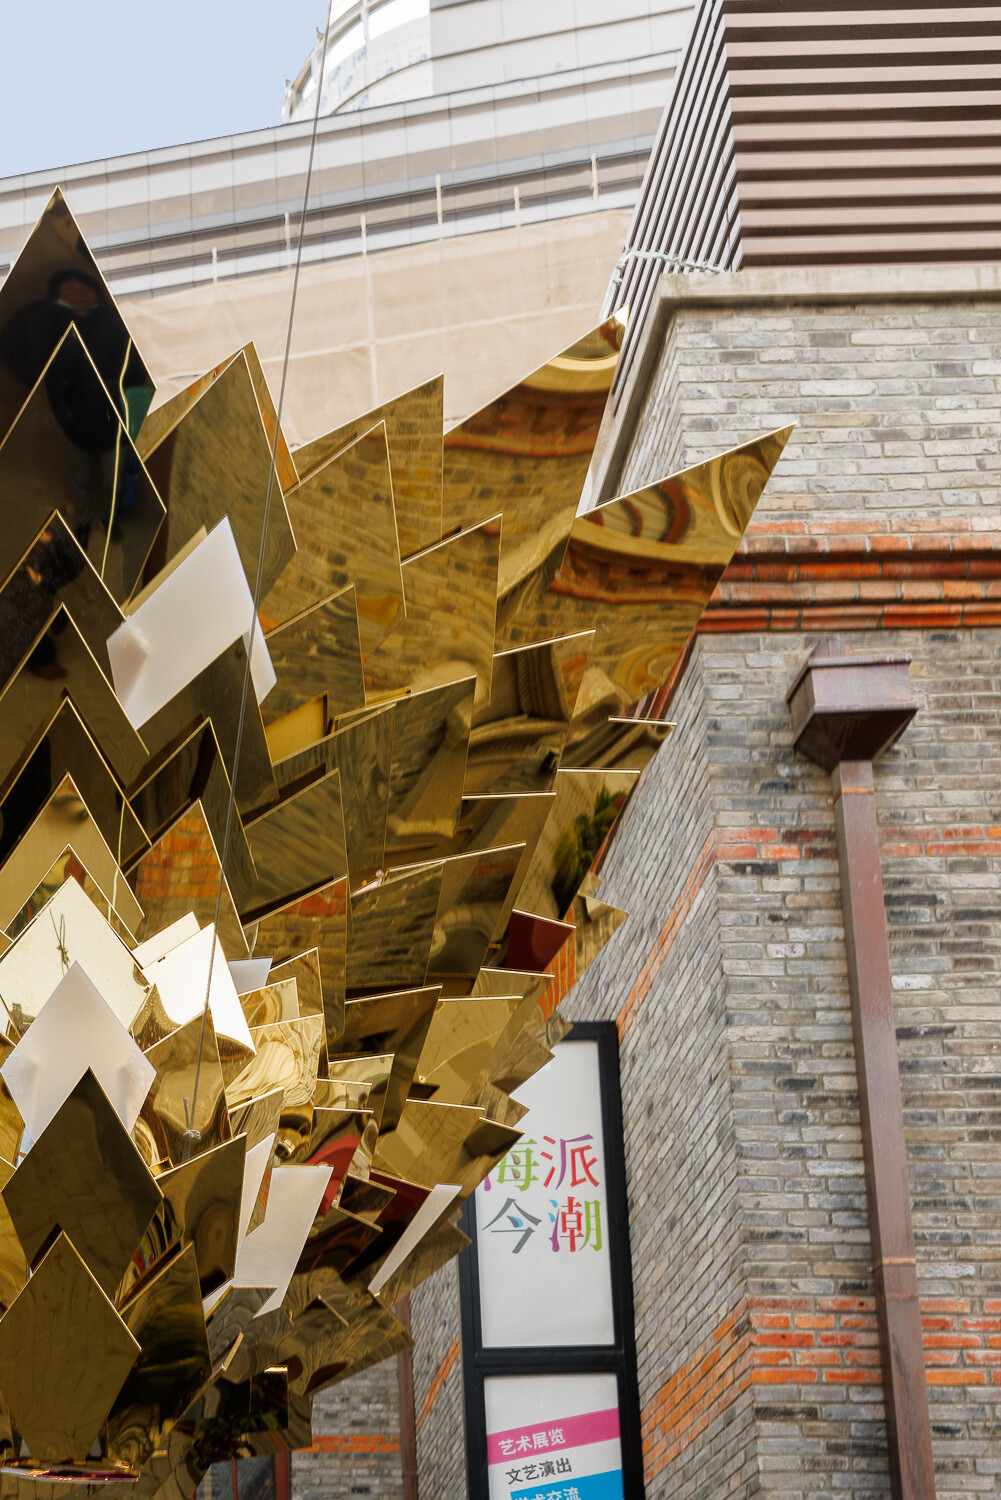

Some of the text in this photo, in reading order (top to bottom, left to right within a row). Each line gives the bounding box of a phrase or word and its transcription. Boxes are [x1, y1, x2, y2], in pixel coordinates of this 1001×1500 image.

[482, 1196, 603, 1254] 今潮
[498, 1428, 566, 1456] 艺术展览
[506, 1457, 572, 1485] 文艺演出
